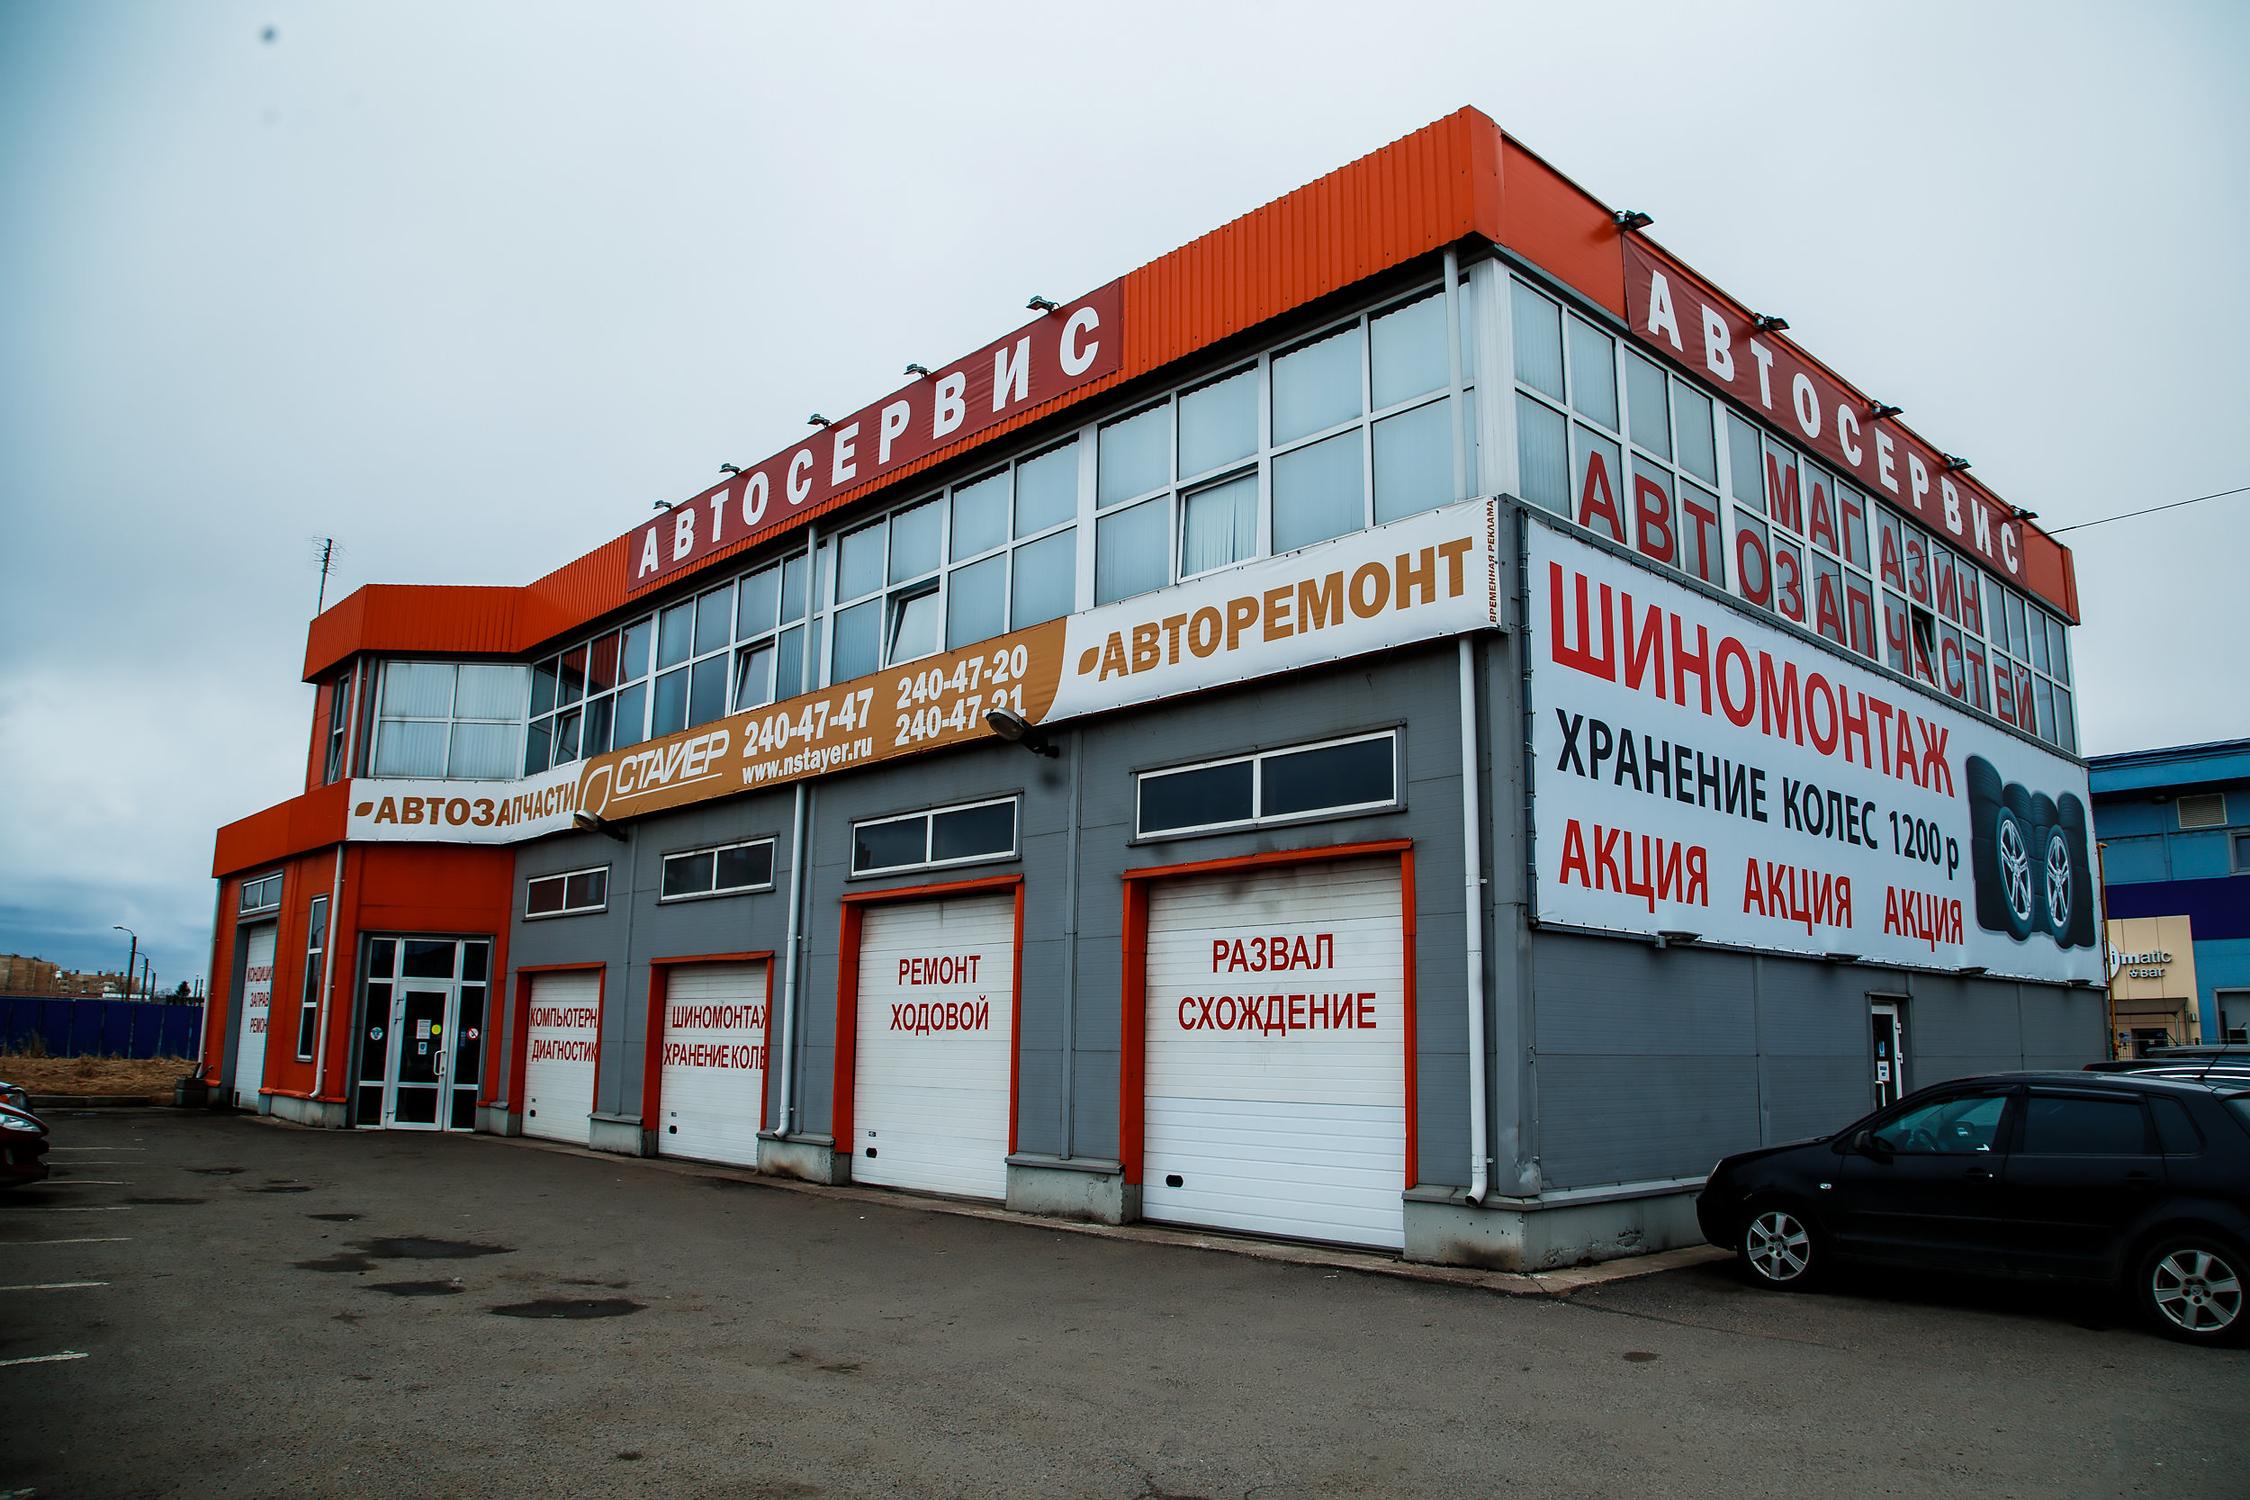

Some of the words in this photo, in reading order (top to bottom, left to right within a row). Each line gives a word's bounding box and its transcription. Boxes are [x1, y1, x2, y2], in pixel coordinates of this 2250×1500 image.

[638, 306, 1100, 578] АВТОСЕРВИС
[1647, 269, 2019, 574] АВТОСЕРВИС
[1486, 500, 1495, 552] РЕКЛАМА
[1767, 451, 1983, 637] МАГАЗИН
[1098, 536, 1473, 682] АВТОРЕМОНТ
[1488, 555, 1497, 623] ВРЕМЕННАЯ
[1579, 451, 2036, 735] АВТОЗАПЧАСТЕЙ
[896, 644, 1028, 709] 240-47-20
[1549, 561, 1955, 798] ШИНОМОНТАЖ
[742, 688, 874, 758] 240-47-47
[895, 684, 1027, 746] 240-47-21
[742, 736, 873, 785] www.nstayer.ru
[1555, 708, 1768, 824] ХРАНЕНИЕ
[1783, 777, 1878, 850] КОЛЕС
[1889, 811, 1941, 866] 1200
[374, 780, 577, 828] АВТОЗАПЧАСТИ
[1559, 819, 1709, 914] АКЦИЯ
[1743, 858, 1852, 936] АКЦИЯ
[1884, 886, 1964, 952] АКЦИЯ
[898, 954, 983, 986] РЕМОНТ
[1212, 932, 1335, 974] РАЗВАЛ
[530, 1007, 598, 1029] КОМПЬЮТЕРН
[890, 995, 990, 1037] ХОДОВОЙ
[1177, 992, 1378, 1037] СХОЖДЕНИЕ
[664, 1043, 729, 1069] ХРАНЕНИЕ
